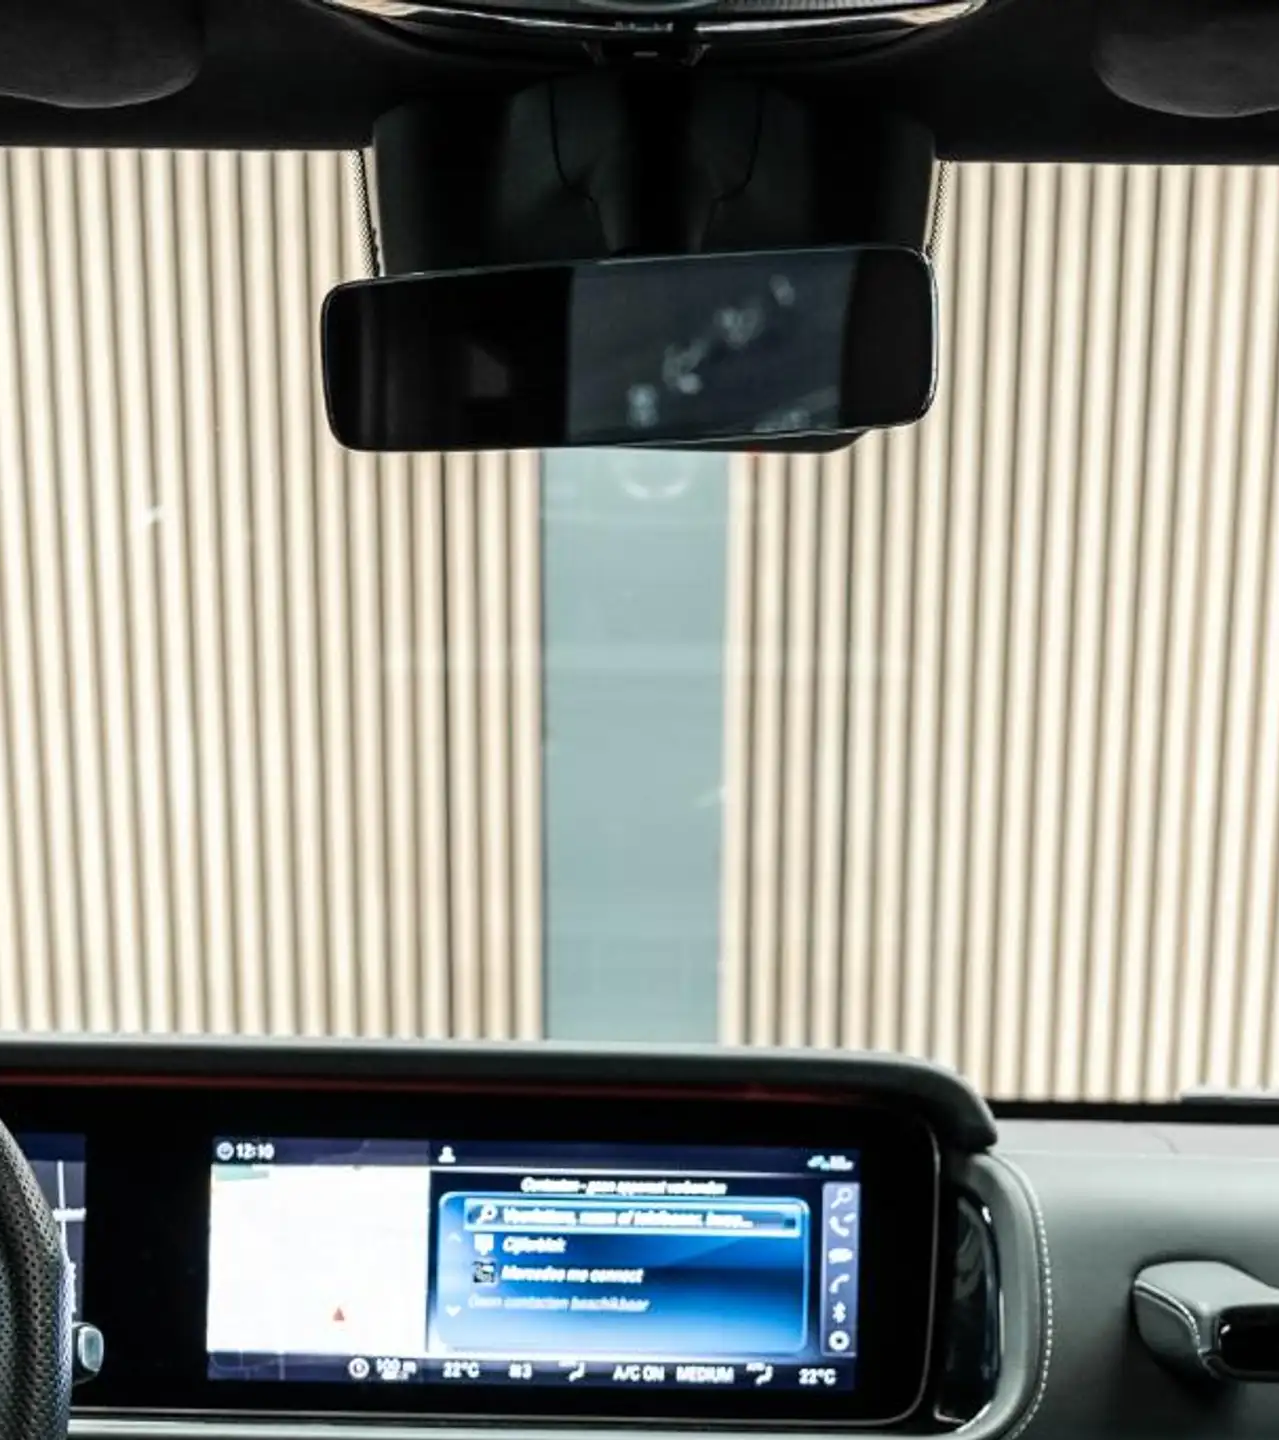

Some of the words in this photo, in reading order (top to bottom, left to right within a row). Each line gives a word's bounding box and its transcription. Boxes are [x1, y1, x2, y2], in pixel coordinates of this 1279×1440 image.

[235, 1142, 275, 1160] 12:10
[613, 1364, 640, 1383] A/C
[642, 1366, 666, 1383] ON
[676, 1365, 735, 1384] MEDIUM
